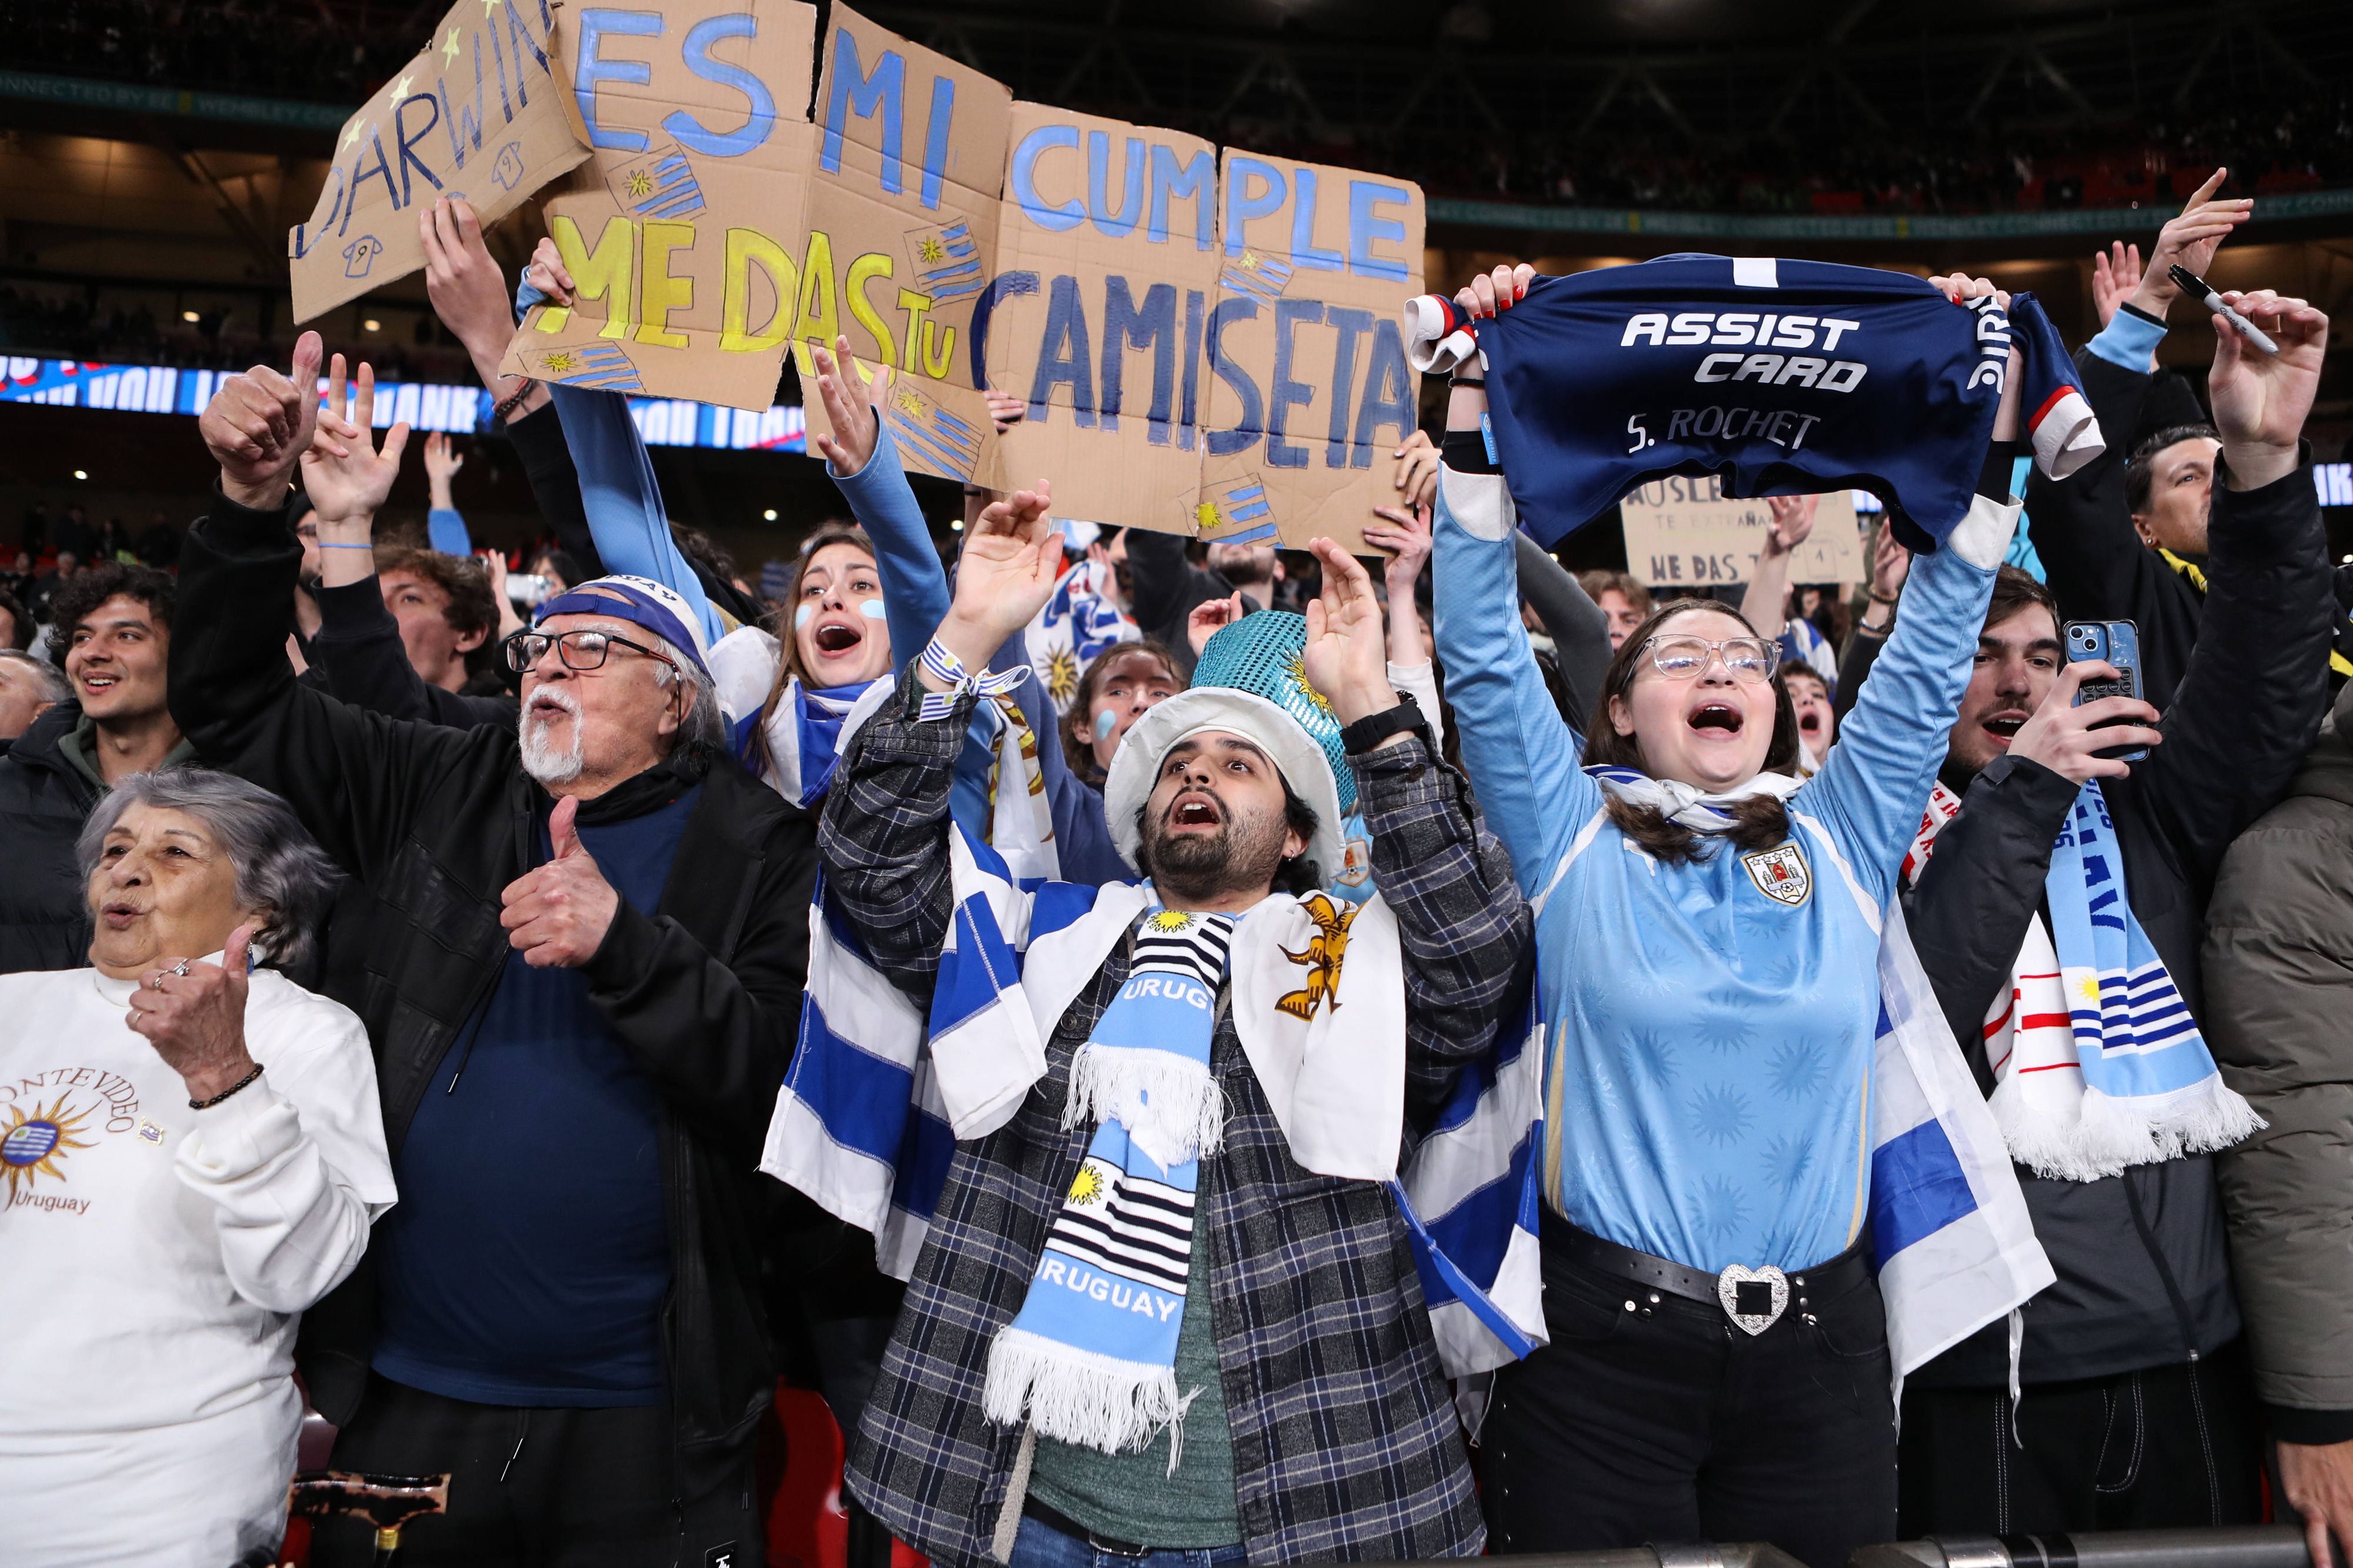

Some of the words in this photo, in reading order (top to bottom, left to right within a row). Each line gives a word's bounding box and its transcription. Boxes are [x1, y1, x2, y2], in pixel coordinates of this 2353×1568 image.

[575, 8, 778, 156] ES
[819, 27, 954, 211] MI
[1011, 124, 1411, 283] CUMPLE
[355, 245, 368, 263] 9
[534, 215, 696, 349] ME
[719, 226, 898, 387] DAS
[1621, 313, 1861, 352] ASSIST
[968, 270, 1418, 469] CAMISETA
[1694, 352, 1868, 393] CARD
[1628, 413, 1655, 453] S.
[1668, 405, 1822, 450] ROCHET
[1692, 554, 1738, 581] DAS
[15, 1189, 91, 1216] Uruguay
